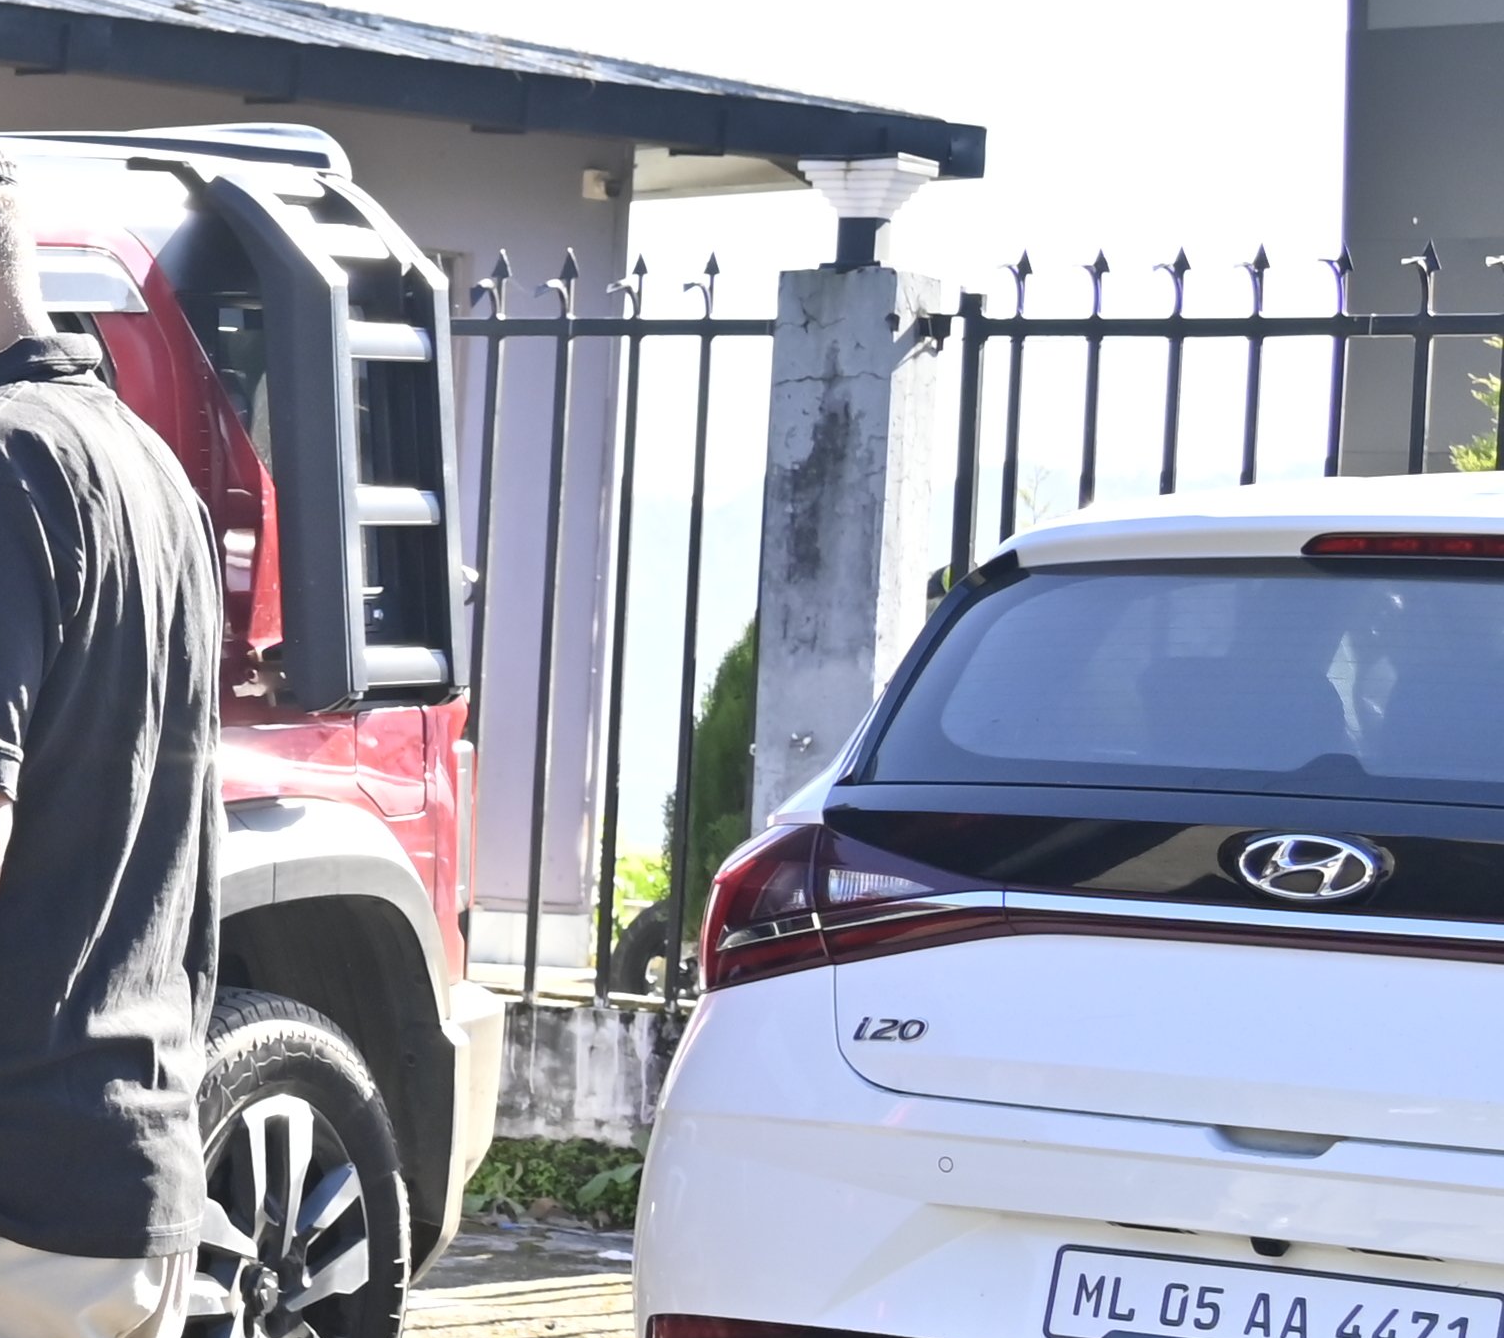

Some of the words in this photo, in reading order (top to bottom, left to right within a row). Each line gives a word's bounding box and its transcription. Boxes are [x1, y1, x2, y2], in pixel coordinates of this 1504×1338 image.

[852, 1016, 927, 1041] i20
[1073, 1273, 1136, 1322] ML
[1159, 1282, 1225, 1330] 05
